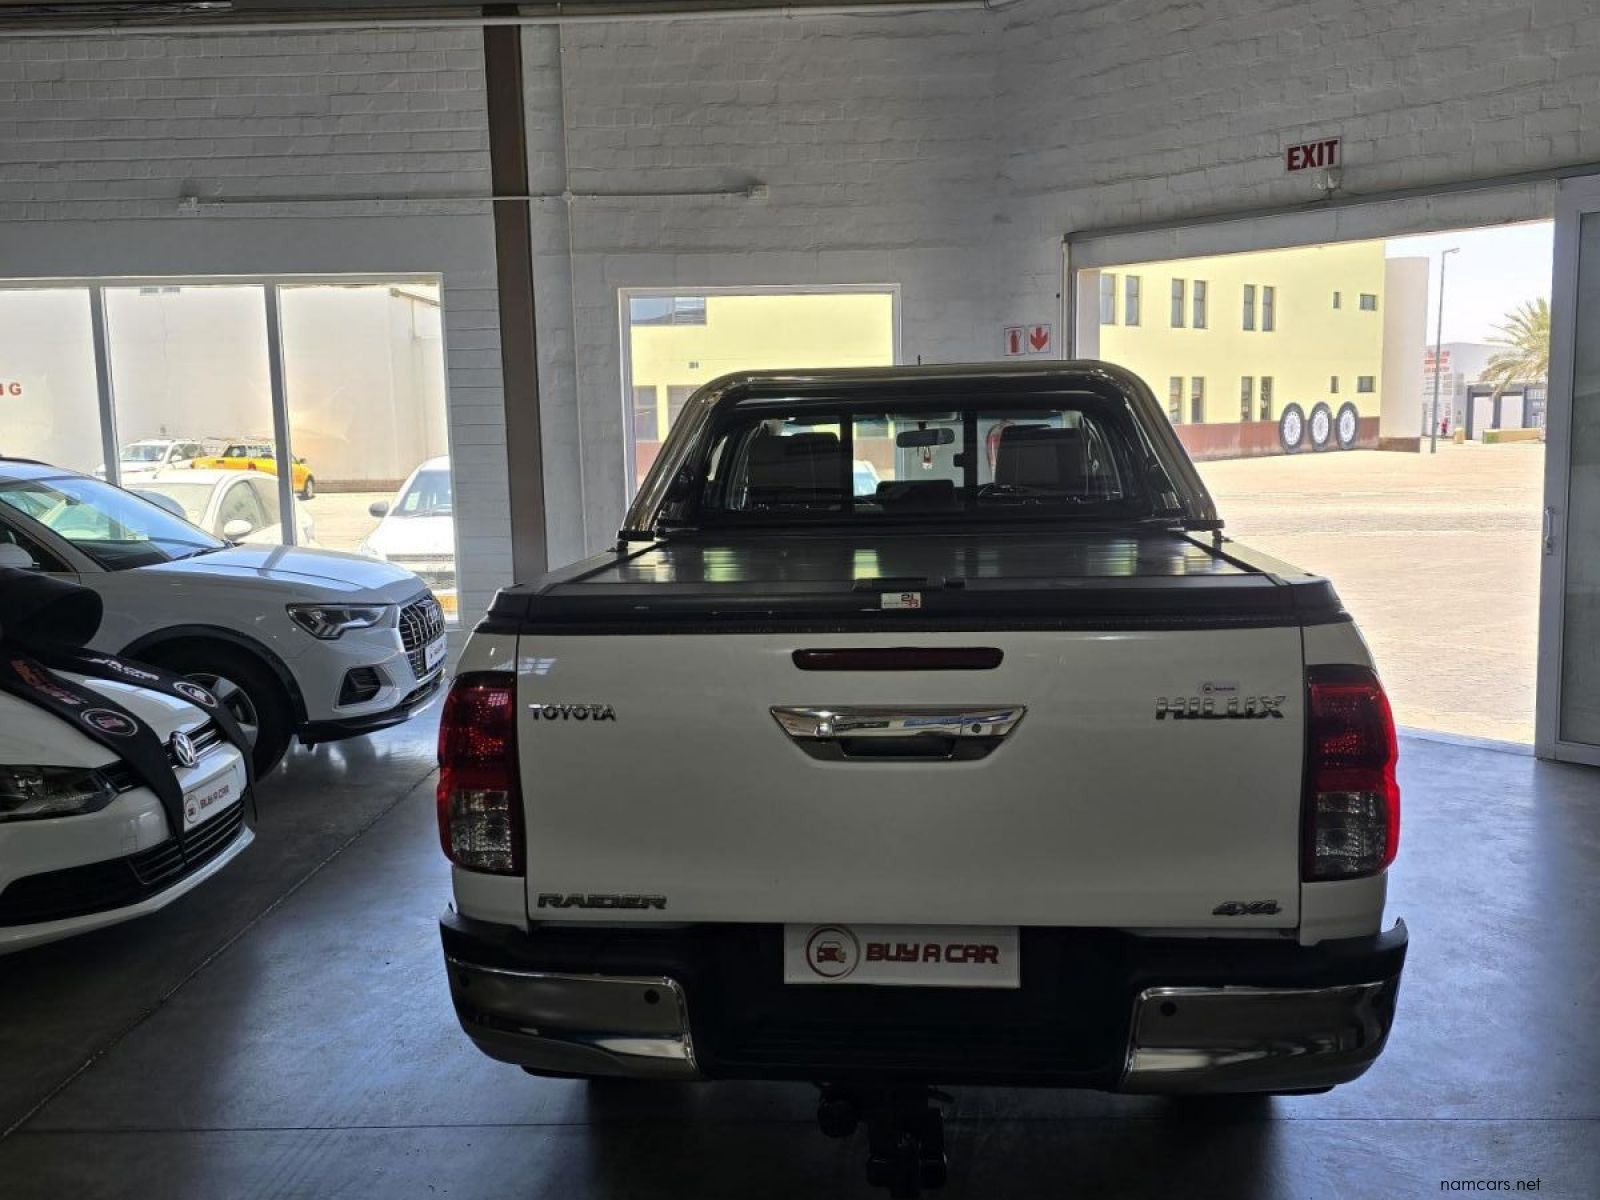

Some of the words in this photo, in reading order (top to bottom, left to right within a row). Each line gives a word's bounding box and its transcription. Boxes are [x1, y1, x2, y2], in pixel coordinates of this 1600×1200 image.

[1287, 139, 1338, 171] EXIT
[528, 703, 616, 721] TOYOTA
[1156, 695, 1286, 720] HILUX
[537, 893, 667, 910] RAIDER
[866, 943, 920, 962] BUY
[922, 943, 941, 963] A
[944, 944, 999, 964] CAR
